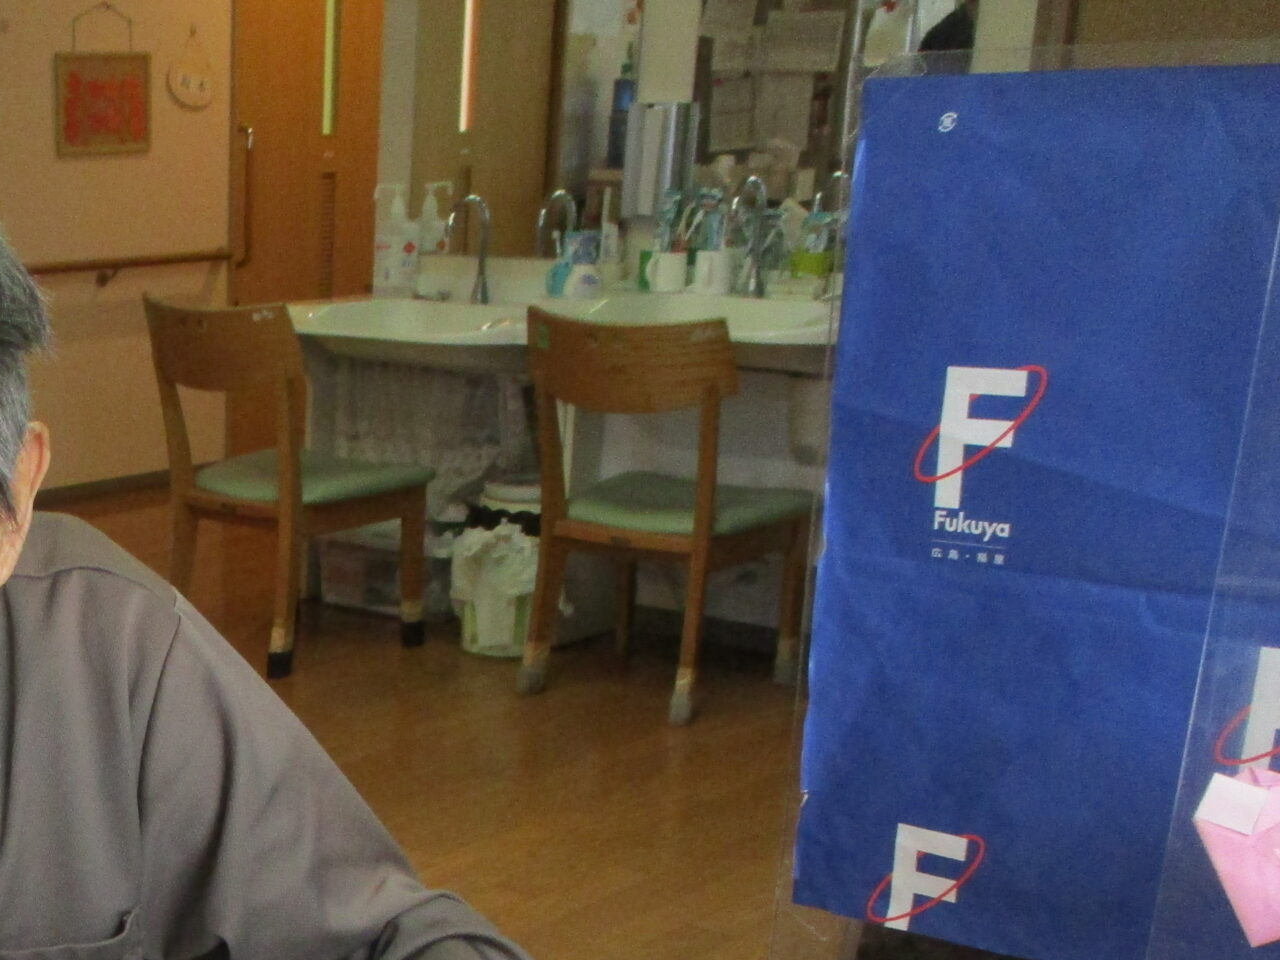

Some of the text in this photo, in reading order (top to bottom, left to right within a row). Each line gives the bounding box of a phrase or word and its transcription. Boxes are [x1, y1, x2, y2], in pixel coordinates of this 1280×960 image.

[933, 366, 1029, 509] F
[933, 510, 1011, 542] Fukuya
[883, 822, 969, 931] F
